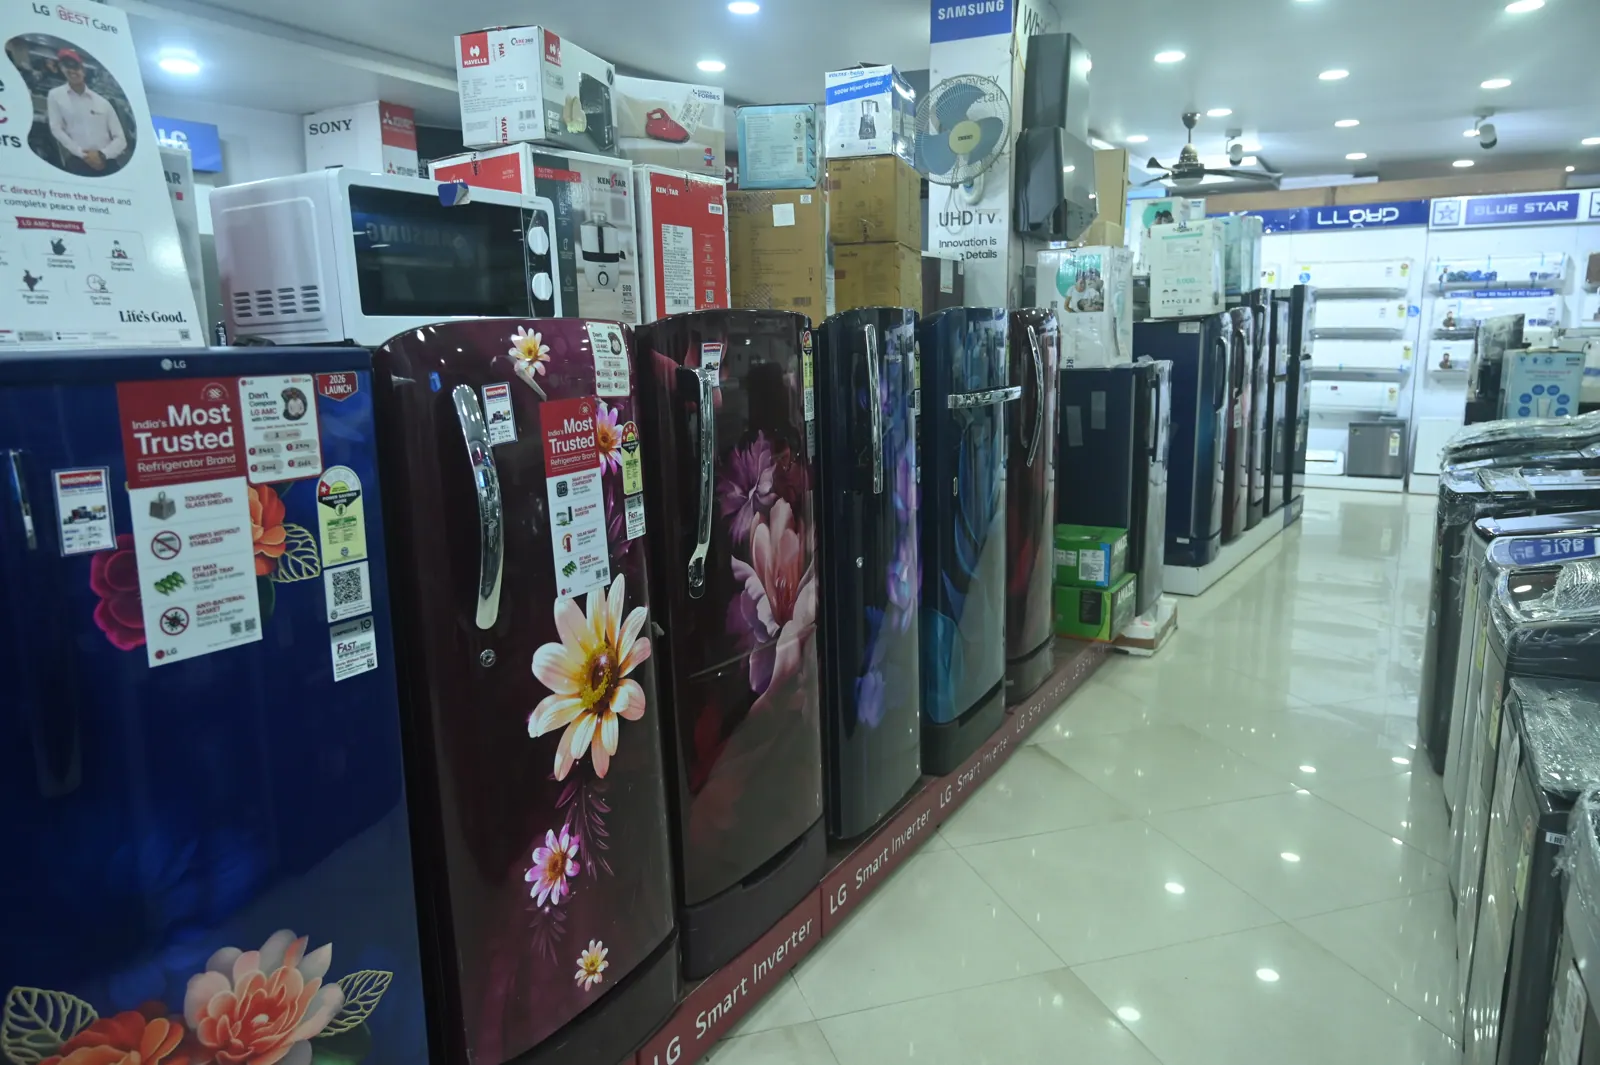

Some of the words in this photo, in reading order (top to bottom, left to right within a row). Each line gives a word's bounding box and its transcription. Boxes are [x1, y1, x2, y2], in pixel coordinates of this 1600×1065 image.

[938, 0, 1004, 20] SAMSUNG
[32, 2, 50, 16] LG
[57, 5, 90, 27] BEST
[92, 18, 118, 34] Care
[464, 57, 487, 66] HAVELLS
[864, 80, 883, 89] Grinder
[309, 119, 352, 136] SONY
[597, 173, 626, 188] KENSTAR
[10, 185, 46, 198] directly
[50, 190, 71, 199] from
[74, 192, 88, 201] the
[90, 194, 115, 204] brand
[117, 197, 131, 206] and
[50, 203, 75, 212] peace
[78, 203, 86, 212] of
[1474, 203, 1518, 215] BLUE
[1524, 200, 1569, 213] STAR
[939, 210, 973, 226] UHD
[939, 237, 987, 249] Innovation
[989, 236, 997, 246] is
[966, 250, 997, 260] Details
[119, 310, 150, 323] Life's
[151, 311, 187, 323] Good.
[174, 360, 187, 369] LG
[329, 374, 346, 384] 2026
[248, 392, 269, 400] Don't
[324, 384, 352, 395] LAUNCH
[249, 400, 277, 408] Compare
[132, 419, 167, 430] India's
[168, 404, 231, 427] Most
[547, 429, 564, 437] India's
[563, 416, 594, 435] Most
[133, 427, 234, 455] Trusted
[549, 432, 595, 454] Trusted
[137, 457, 204, 473] Refrigerator
[206, 454, 236, 466] Brand
[551, 455, 581, 466] Refrigerator
[581, 452, 596, 460] Brand
[184, 492, 223, 502] TOUGHENED
[185, 501, 207, 509] GLASS
[207, 497, 233, 507] SHELVES
[188, 532, 213, 541] WORKS
[213, 526, 240, 537] WITHOUT
[189, 536, 224, 548] STABILIZER
[192, 569, 218, 579] CHILLER
[218, 566, 234, 574] TRAY
[196, 595, 246, 609] ANTI-BACTERIAL
[196, 605, 220, 616] GASKET
[166, 648, 178, 656] LG
[336, 641, 356, 654] FAST
[1016, 714, 1025, 733] LG
[940, 785, 952, 808] LG
[957, 762, 981, 791] Smart
[982, 736, 1010, 767] Inverter
[830, 884, 847, 914] LG
[855, 848, 889, 889] Smart
[891, 809, 931, 855] Inverter
[695, 978, 748, 1039] Smart
[753, 918, 812, 984] Inverter
